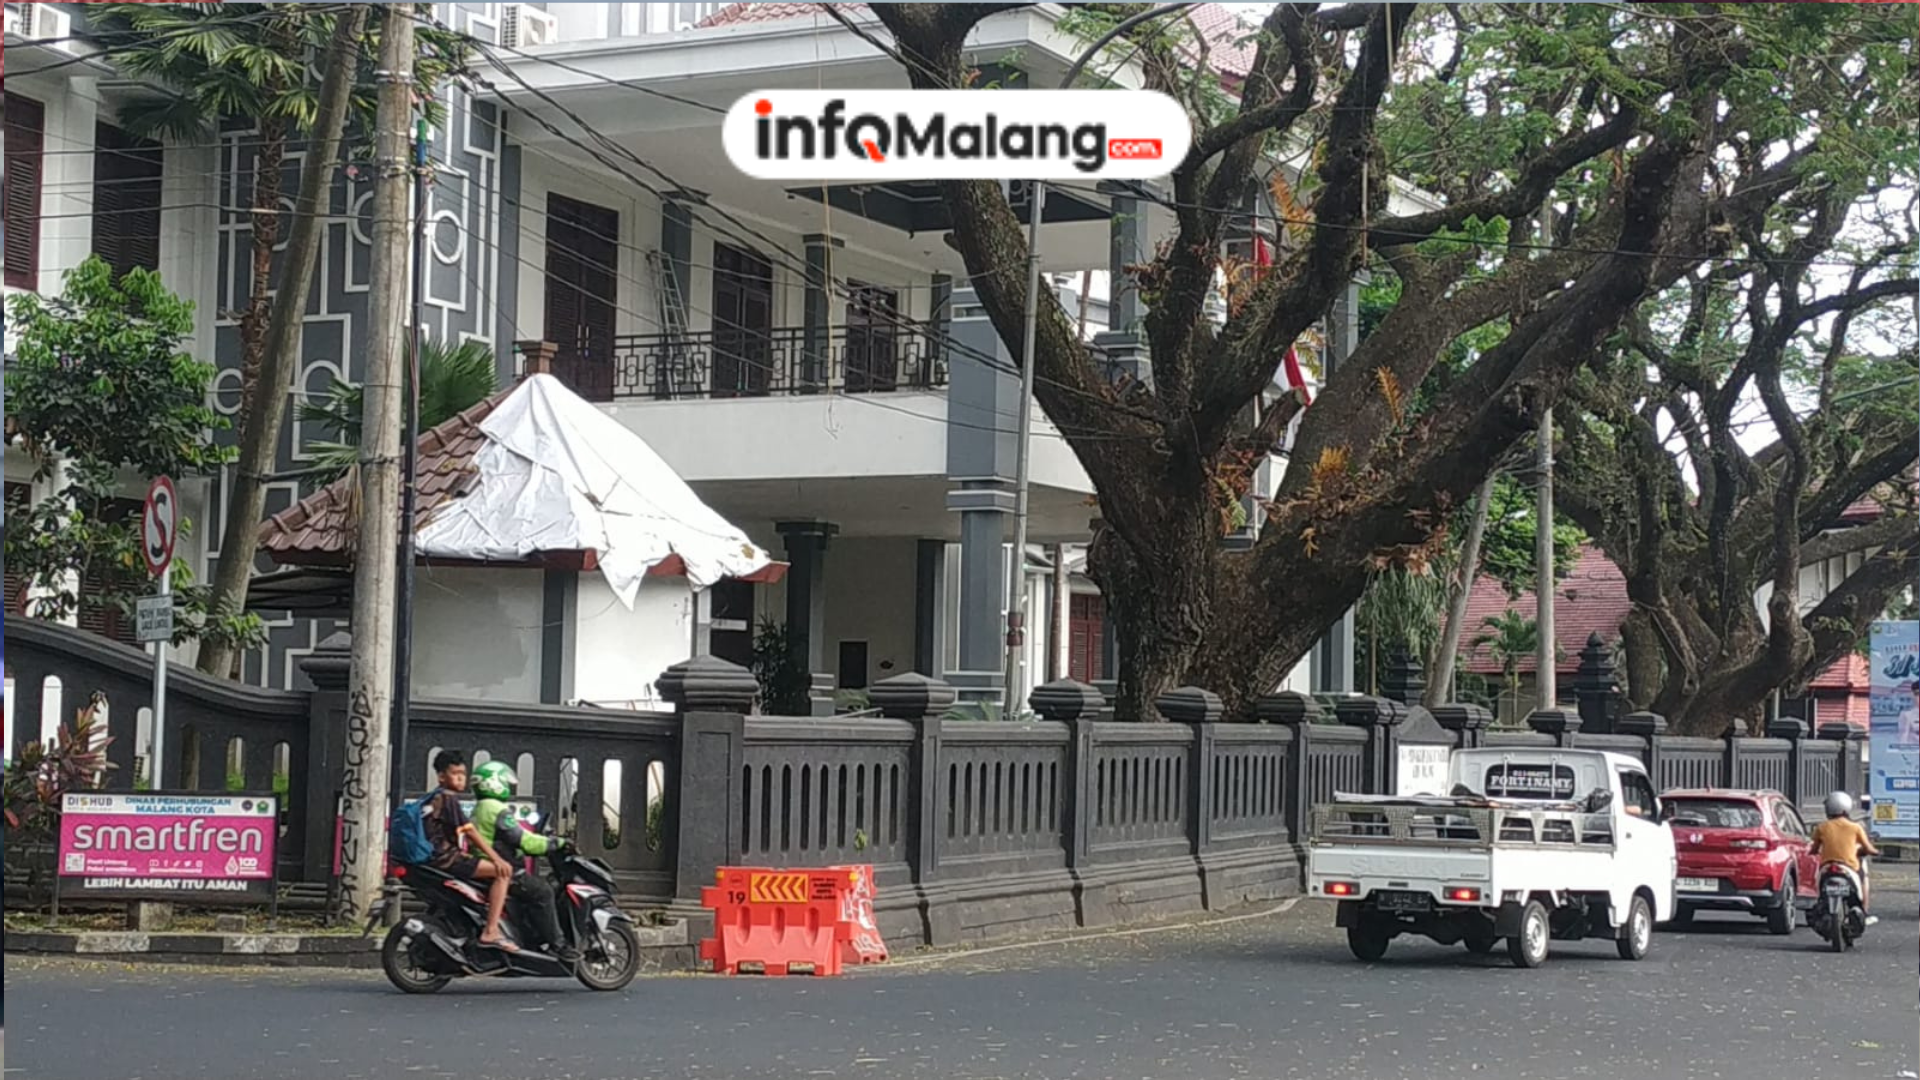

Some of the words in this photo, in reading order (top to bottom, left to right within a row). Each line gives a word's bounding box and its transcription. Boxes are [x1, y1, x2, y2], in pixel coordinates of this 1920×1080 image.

[157, 797, 231, 805] PERHUBUNGAN
[136, 805, 182, 813] MALANG
[186, 806, 215, 814] KOTA
[73, 819, 262, 852] smartfren
[84, 878, 123, 888] LEBIH
[125, 878, 181, 889] LAMBAT
[182, 880, 204, 889] ITU
[205, 880, 247, 891] AMAN
[728, 890, 745, 904] 19
